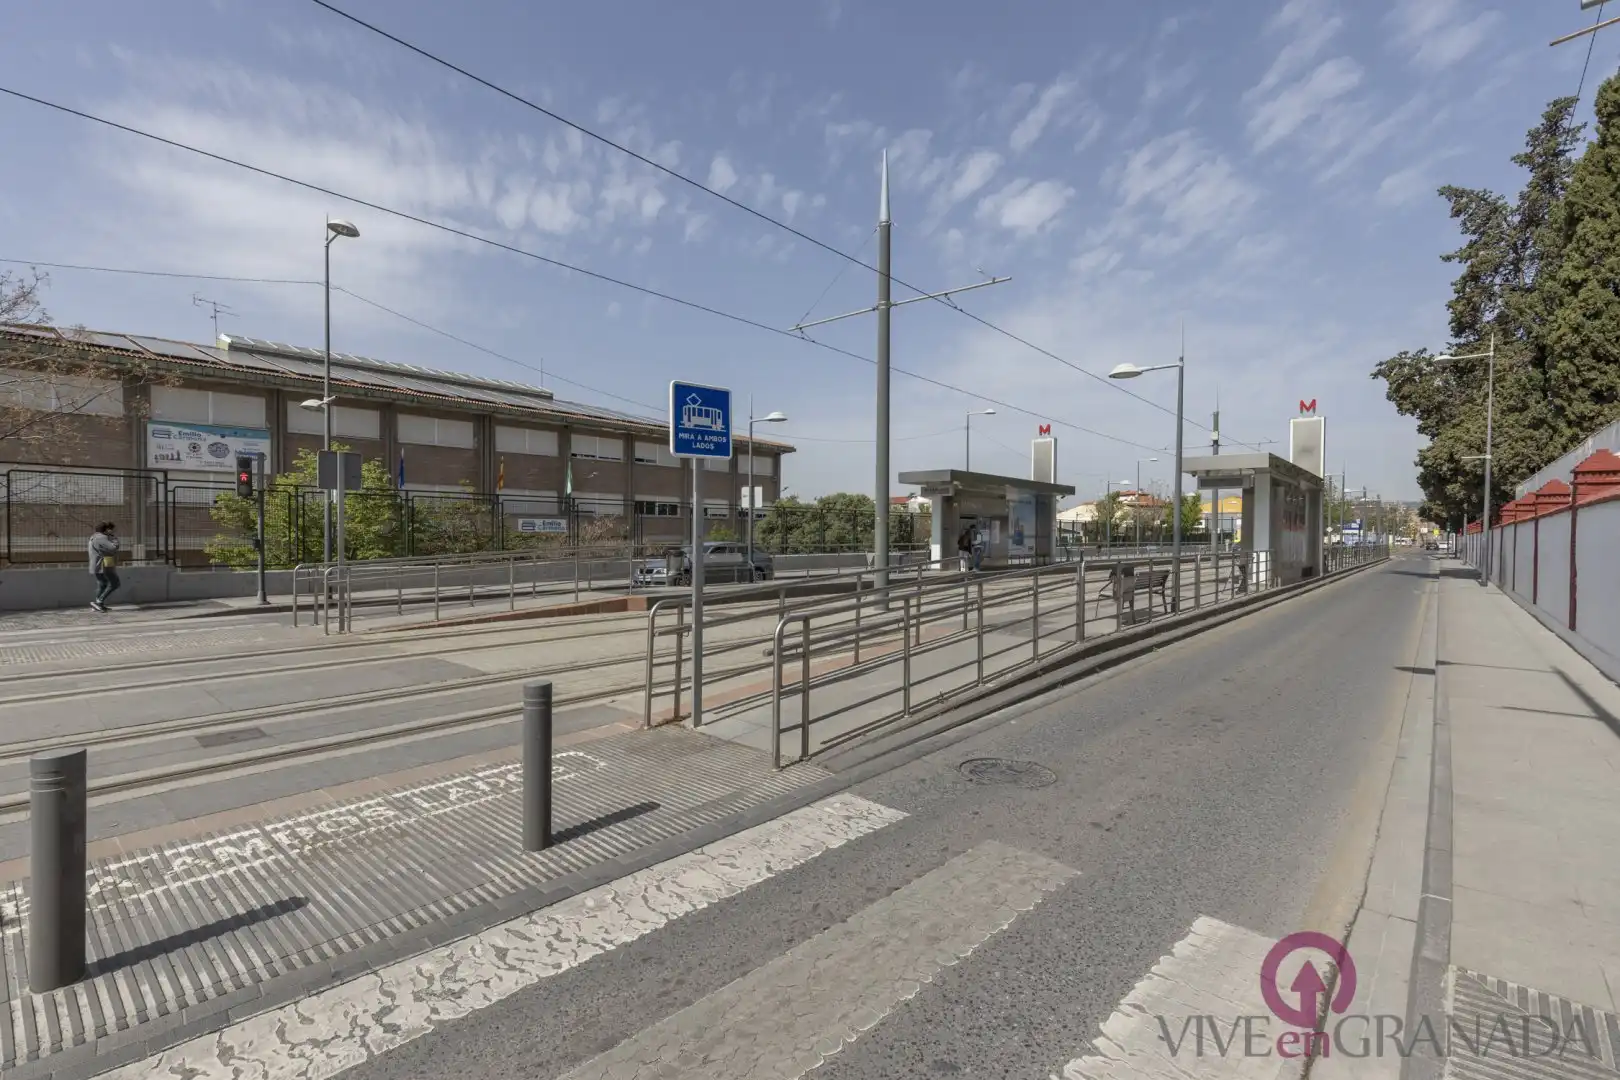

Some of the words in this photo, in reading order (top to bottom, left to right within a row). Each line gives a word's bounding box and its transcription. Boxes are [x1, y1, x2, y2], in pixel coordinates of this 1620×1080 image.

[1299, 399, 1317, 414] M
[1038, 423, 1051, 436] M
[178, 430, 202, 438] Emilio
[704, 435, 727, 443] AMBOS
[692, 442, 715, 450] LADOS
